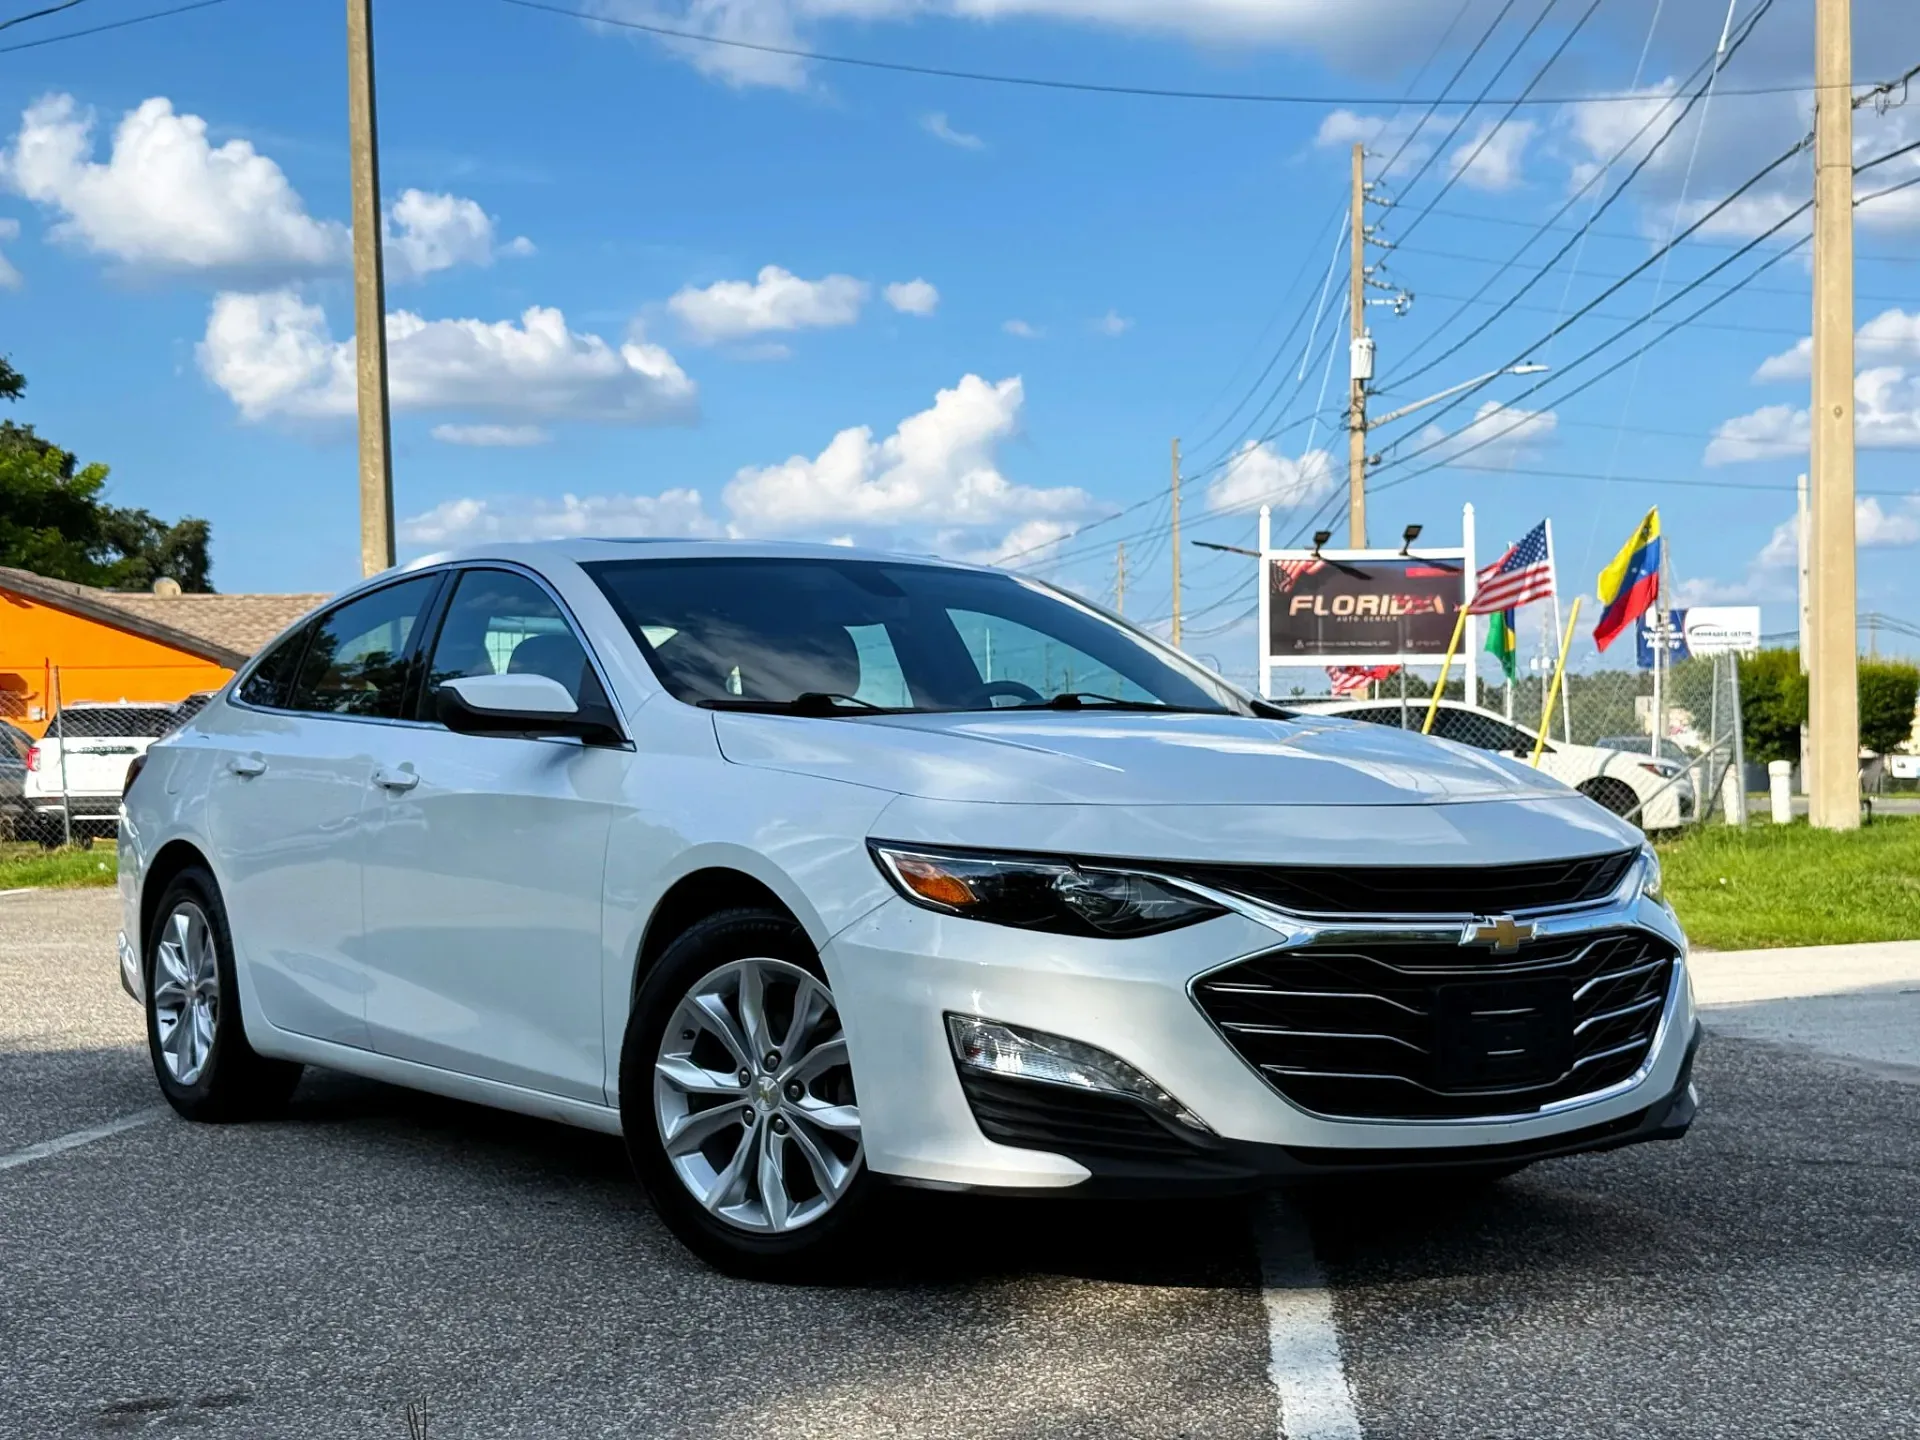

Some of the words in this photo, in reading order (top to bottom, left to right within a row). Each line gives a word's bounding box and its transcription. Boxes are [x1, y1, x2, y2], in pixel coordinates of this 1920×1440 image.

[1289, 594, 1445, 617] FLORIDA
[1336, 615, 1360, 623] AUTO
[1363, 615, 1399, 623] CENTER
